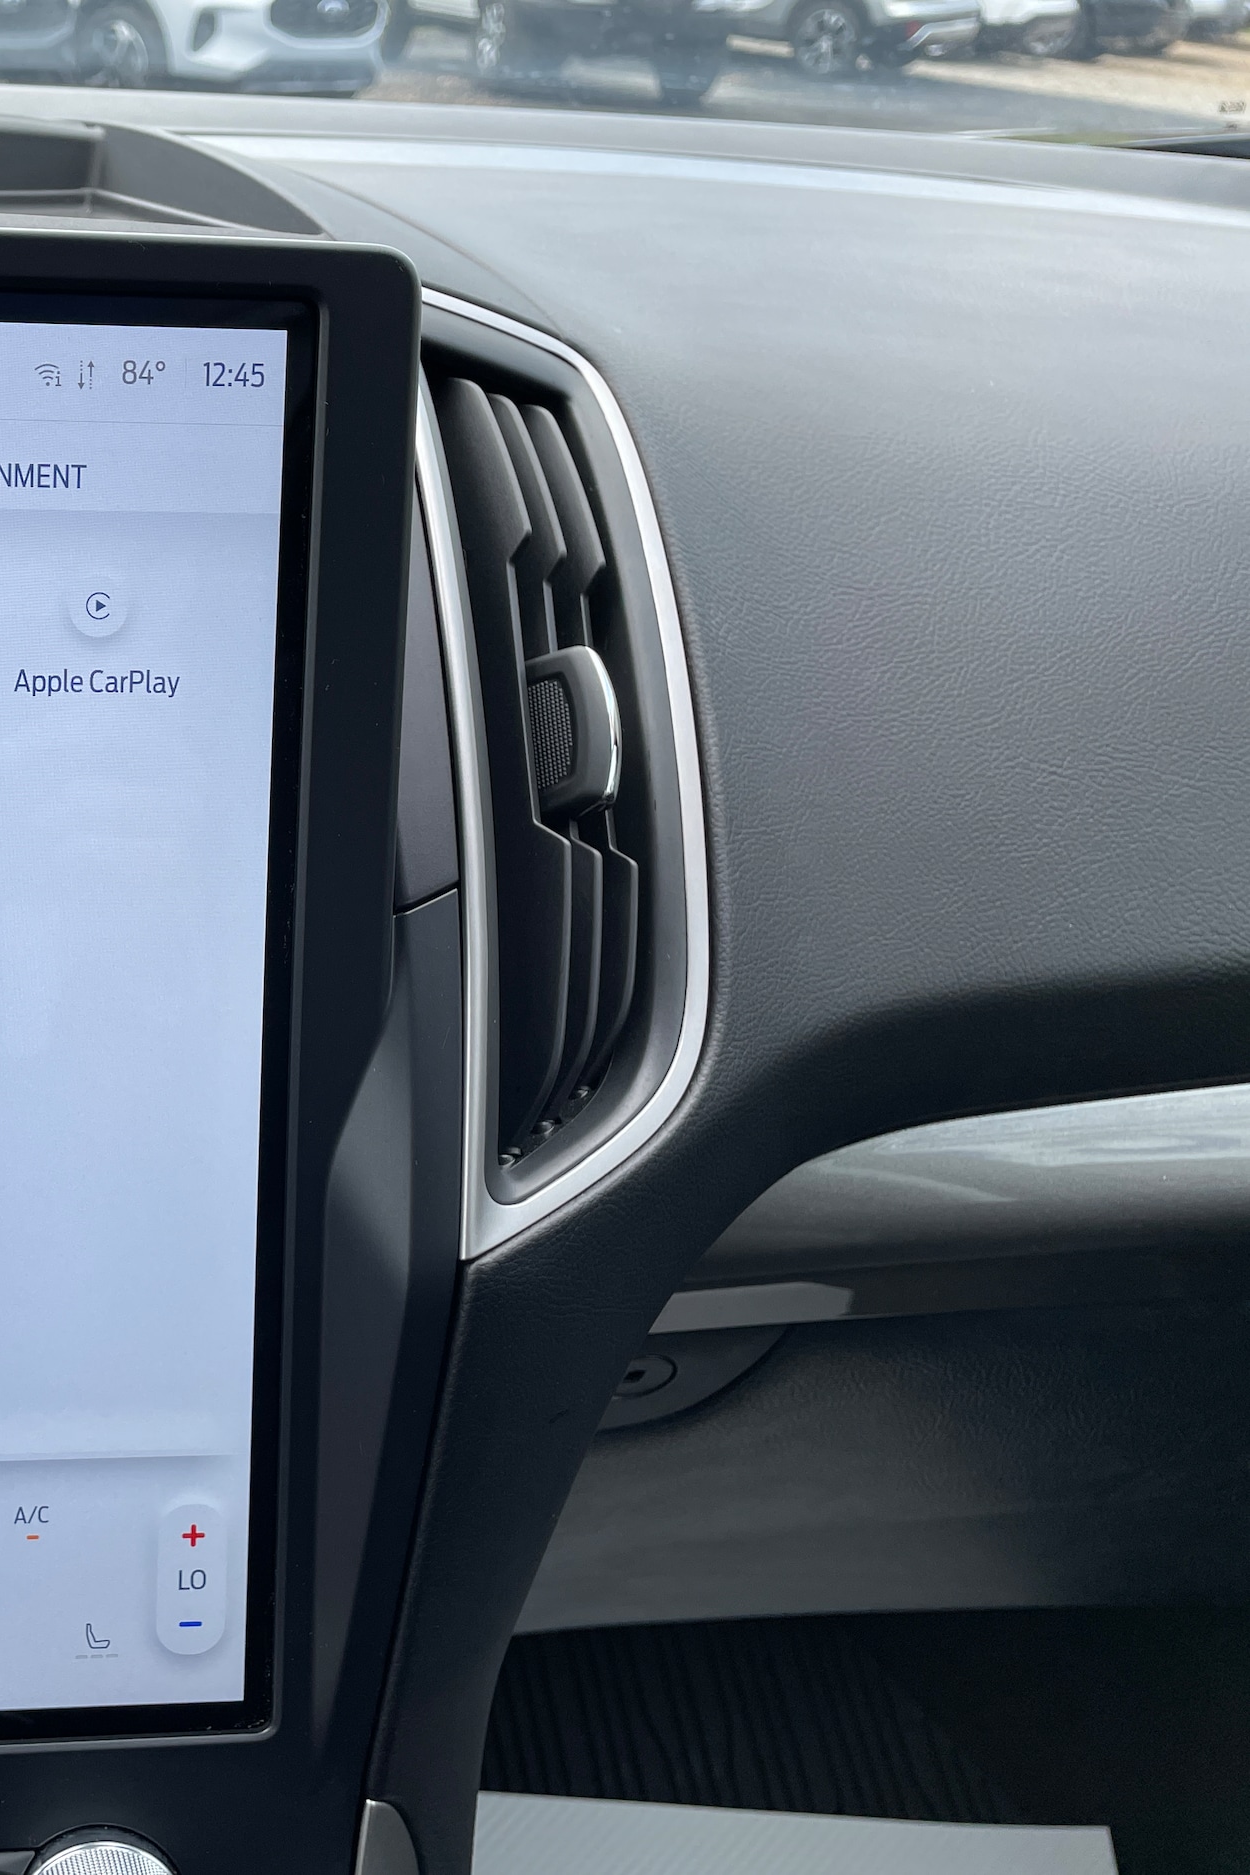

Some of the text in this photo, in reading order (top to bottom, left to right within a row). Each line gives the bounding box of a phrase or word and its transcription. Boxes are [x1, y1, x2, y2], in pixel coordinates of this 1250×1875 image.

[122, 359, 166, 386] 84°
[203, 361, 265, 388] 12:45
[13, 668, 181, 698] Apple CarPlay
[13, 1505, 50, 1525] A/C
[178, 1569, 207, 1591] LO
